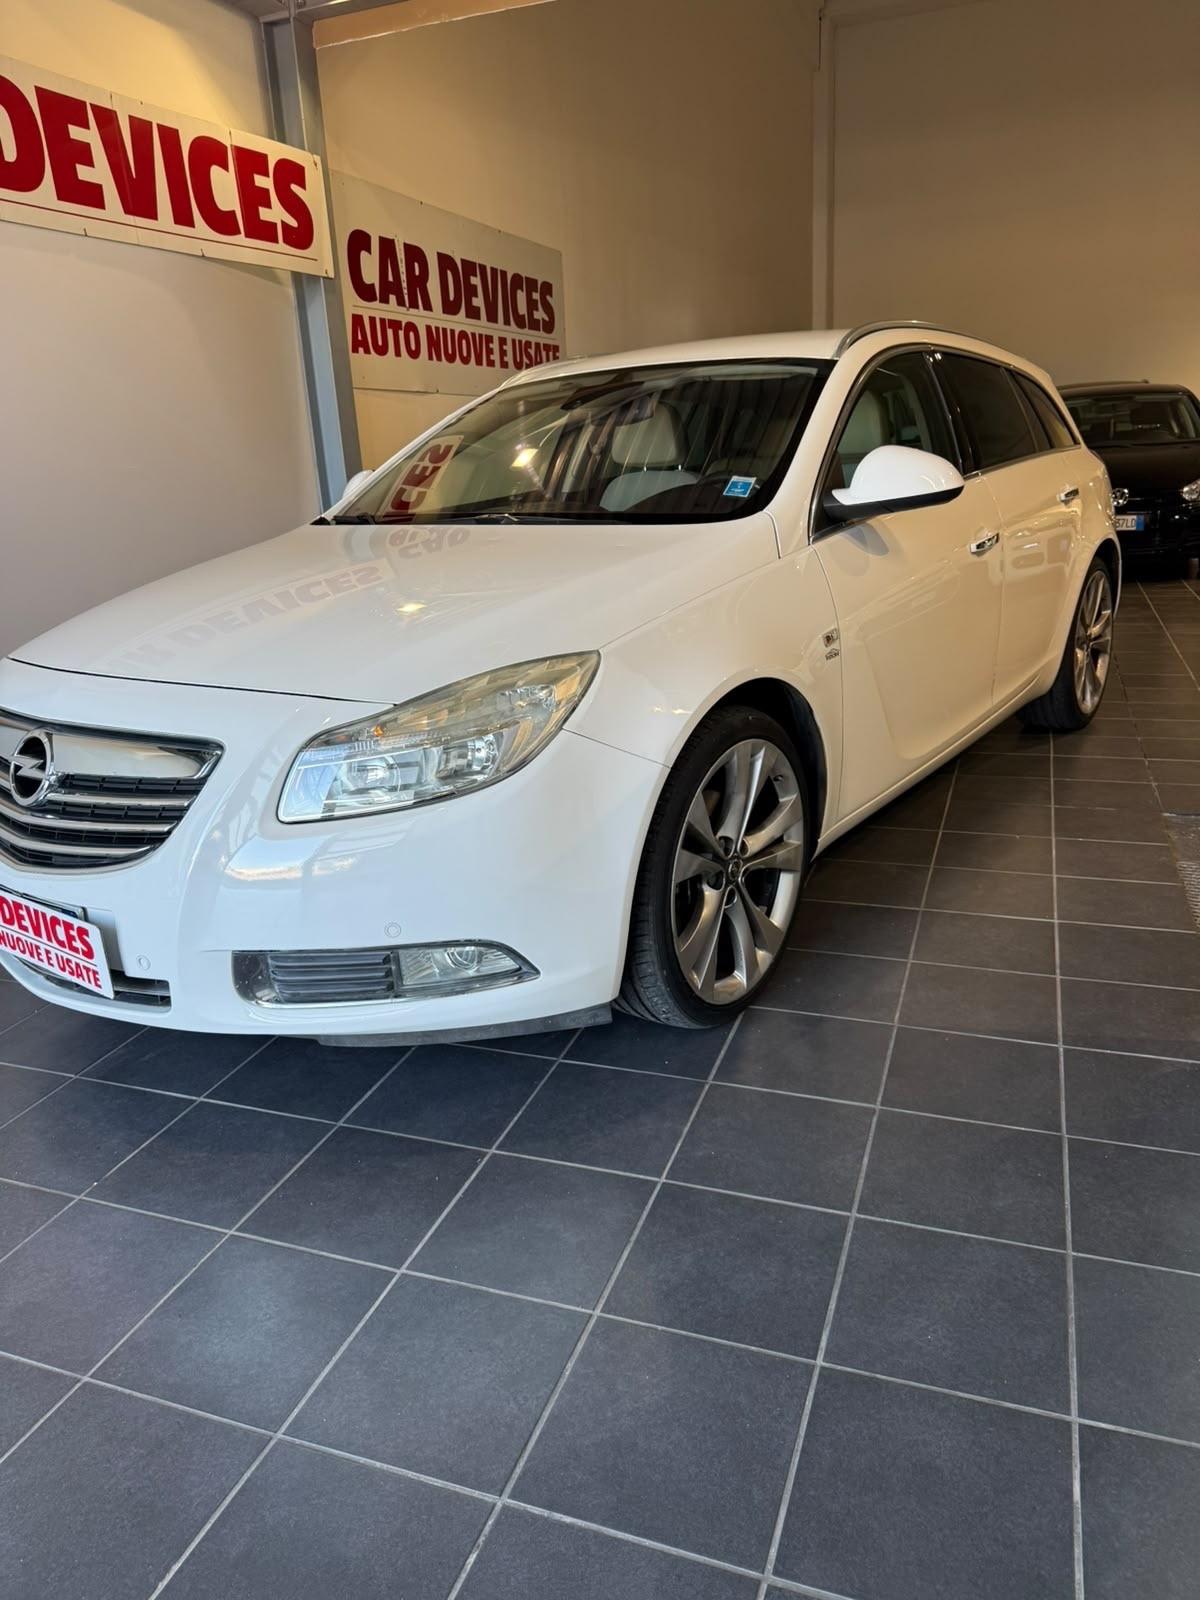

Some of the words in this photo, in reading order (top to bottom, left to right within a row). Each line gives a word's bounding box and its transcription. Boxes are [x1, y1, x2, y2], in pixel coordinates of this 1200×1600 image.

[348, 229, 433, 311] CAR
[437, 252, 555, 334] DEVICES
[352, 313, 420, 359] AUTO
[425, 325, 495, 367] NUOVE
[498, 336, 509, 369] E
[511, 338, 560, 370] USATE
[0, 896, 94, 960] DEVICES
[44, 948, 55, 968] E
[55, 952, 102, 988] USATE
